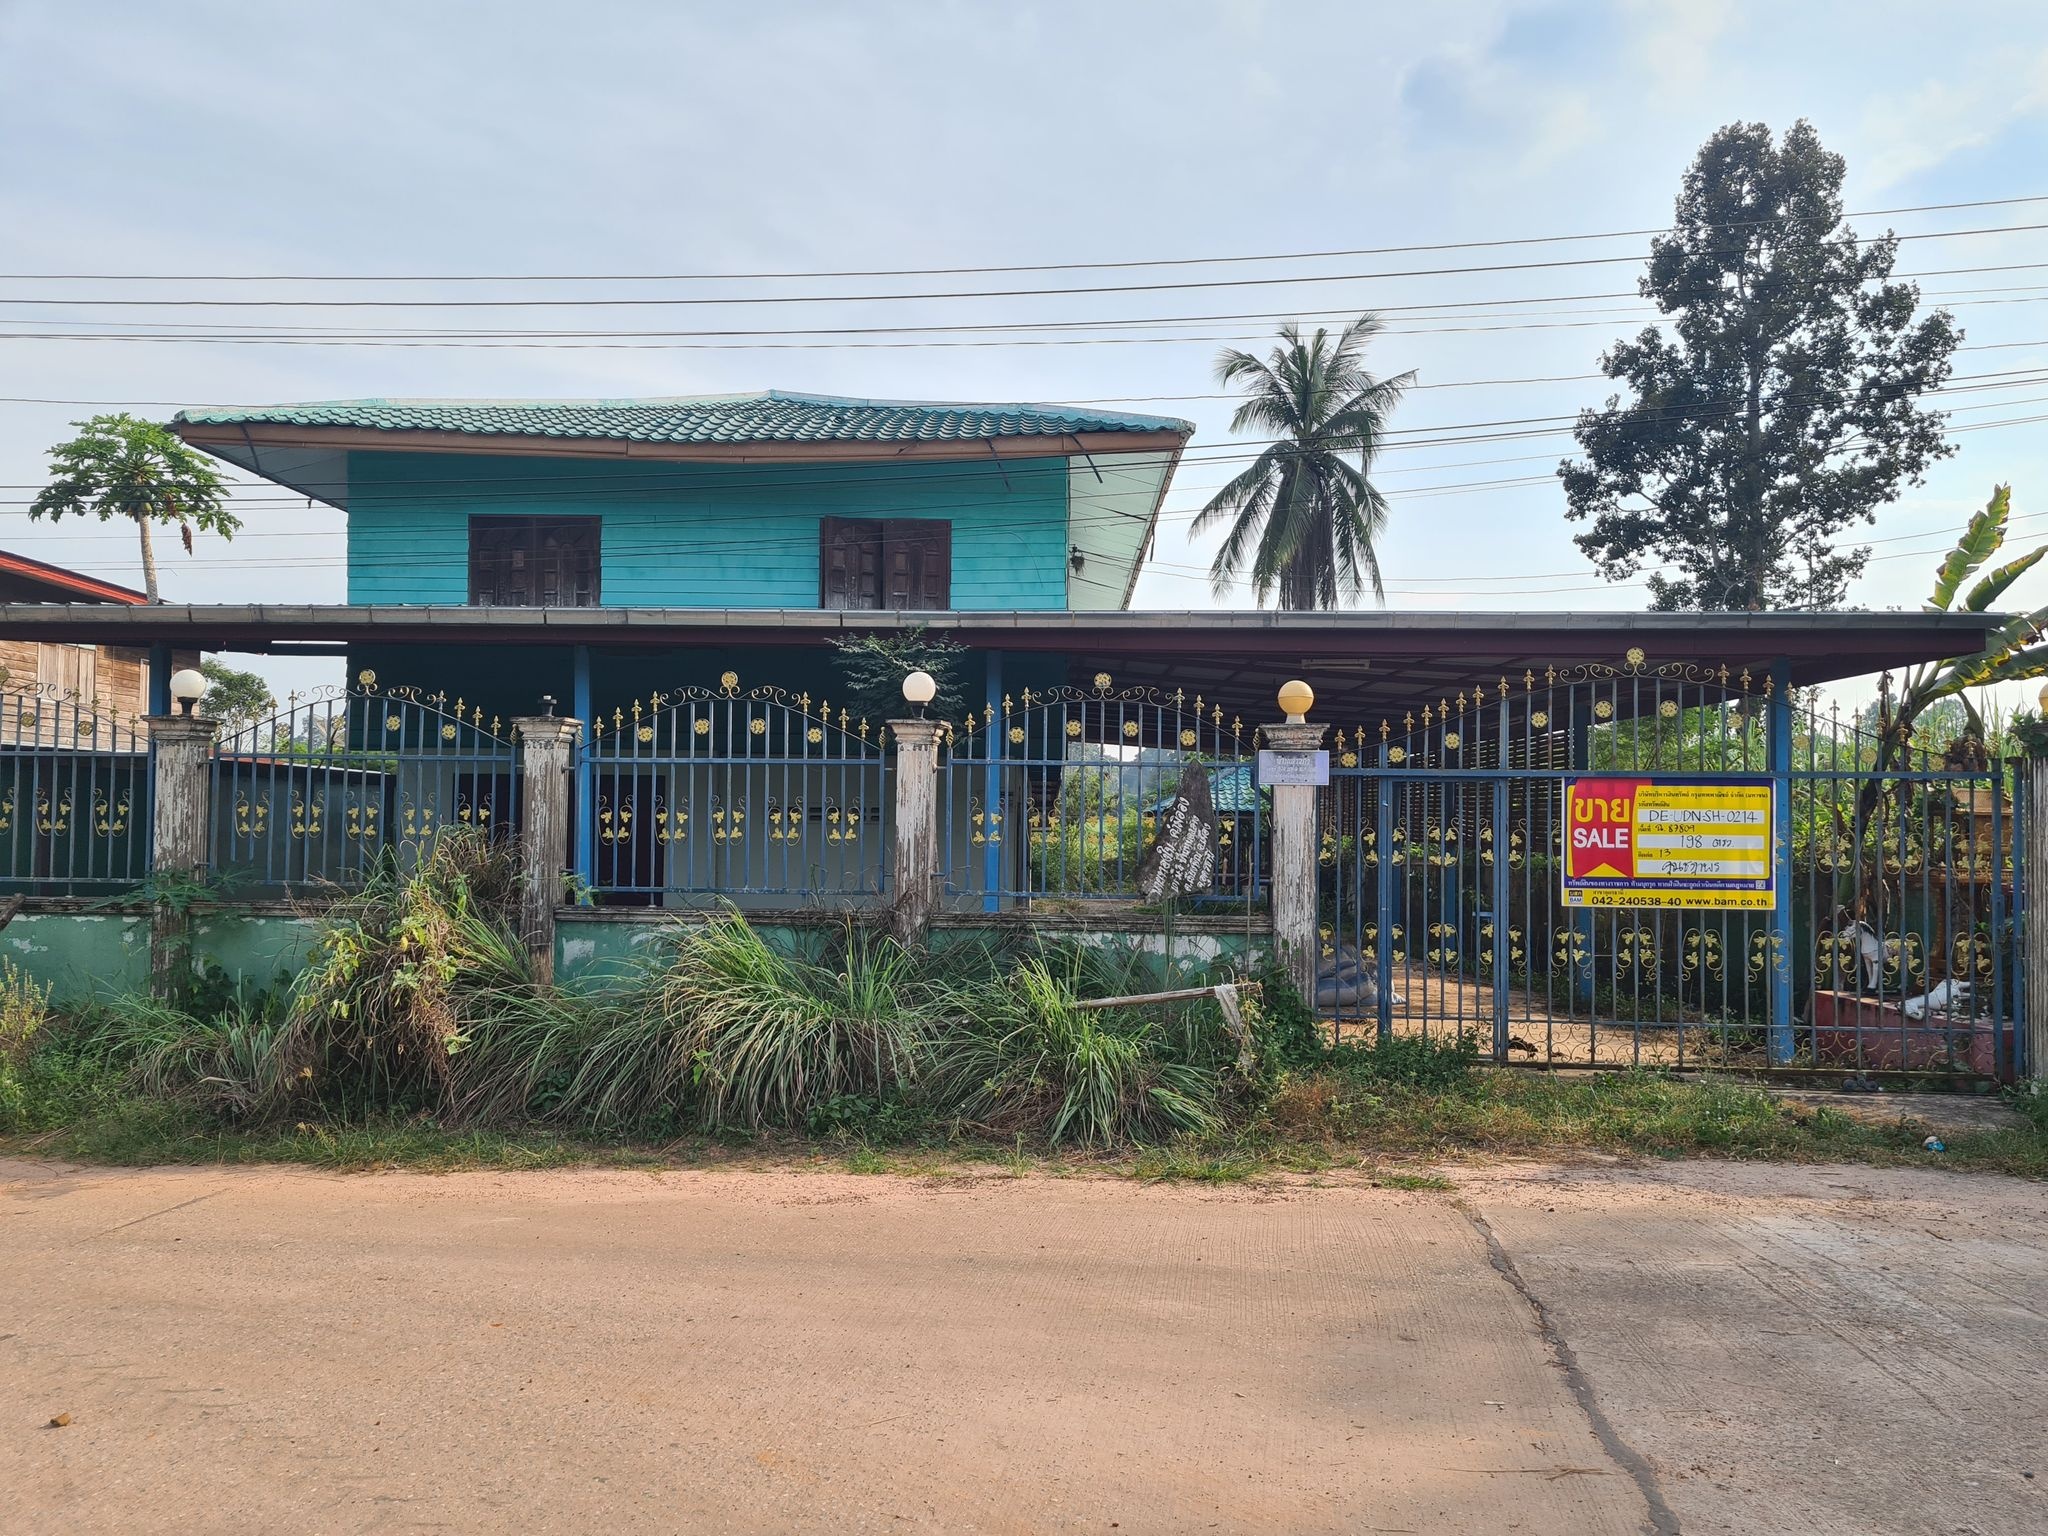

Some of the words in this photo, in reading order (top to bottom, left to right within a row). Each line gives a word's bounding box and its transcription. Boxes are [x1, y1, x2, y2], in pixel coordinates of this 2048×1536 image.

[1575, 798, 1630, 823] ขาย
[1573, 827, 1629, 849] SALE
[1680, 834, 1703, 849] 198
[1591, 896, 1682, 906] 042-240538-40
[1686, 897, 1768, 907] www.bam.co.th
